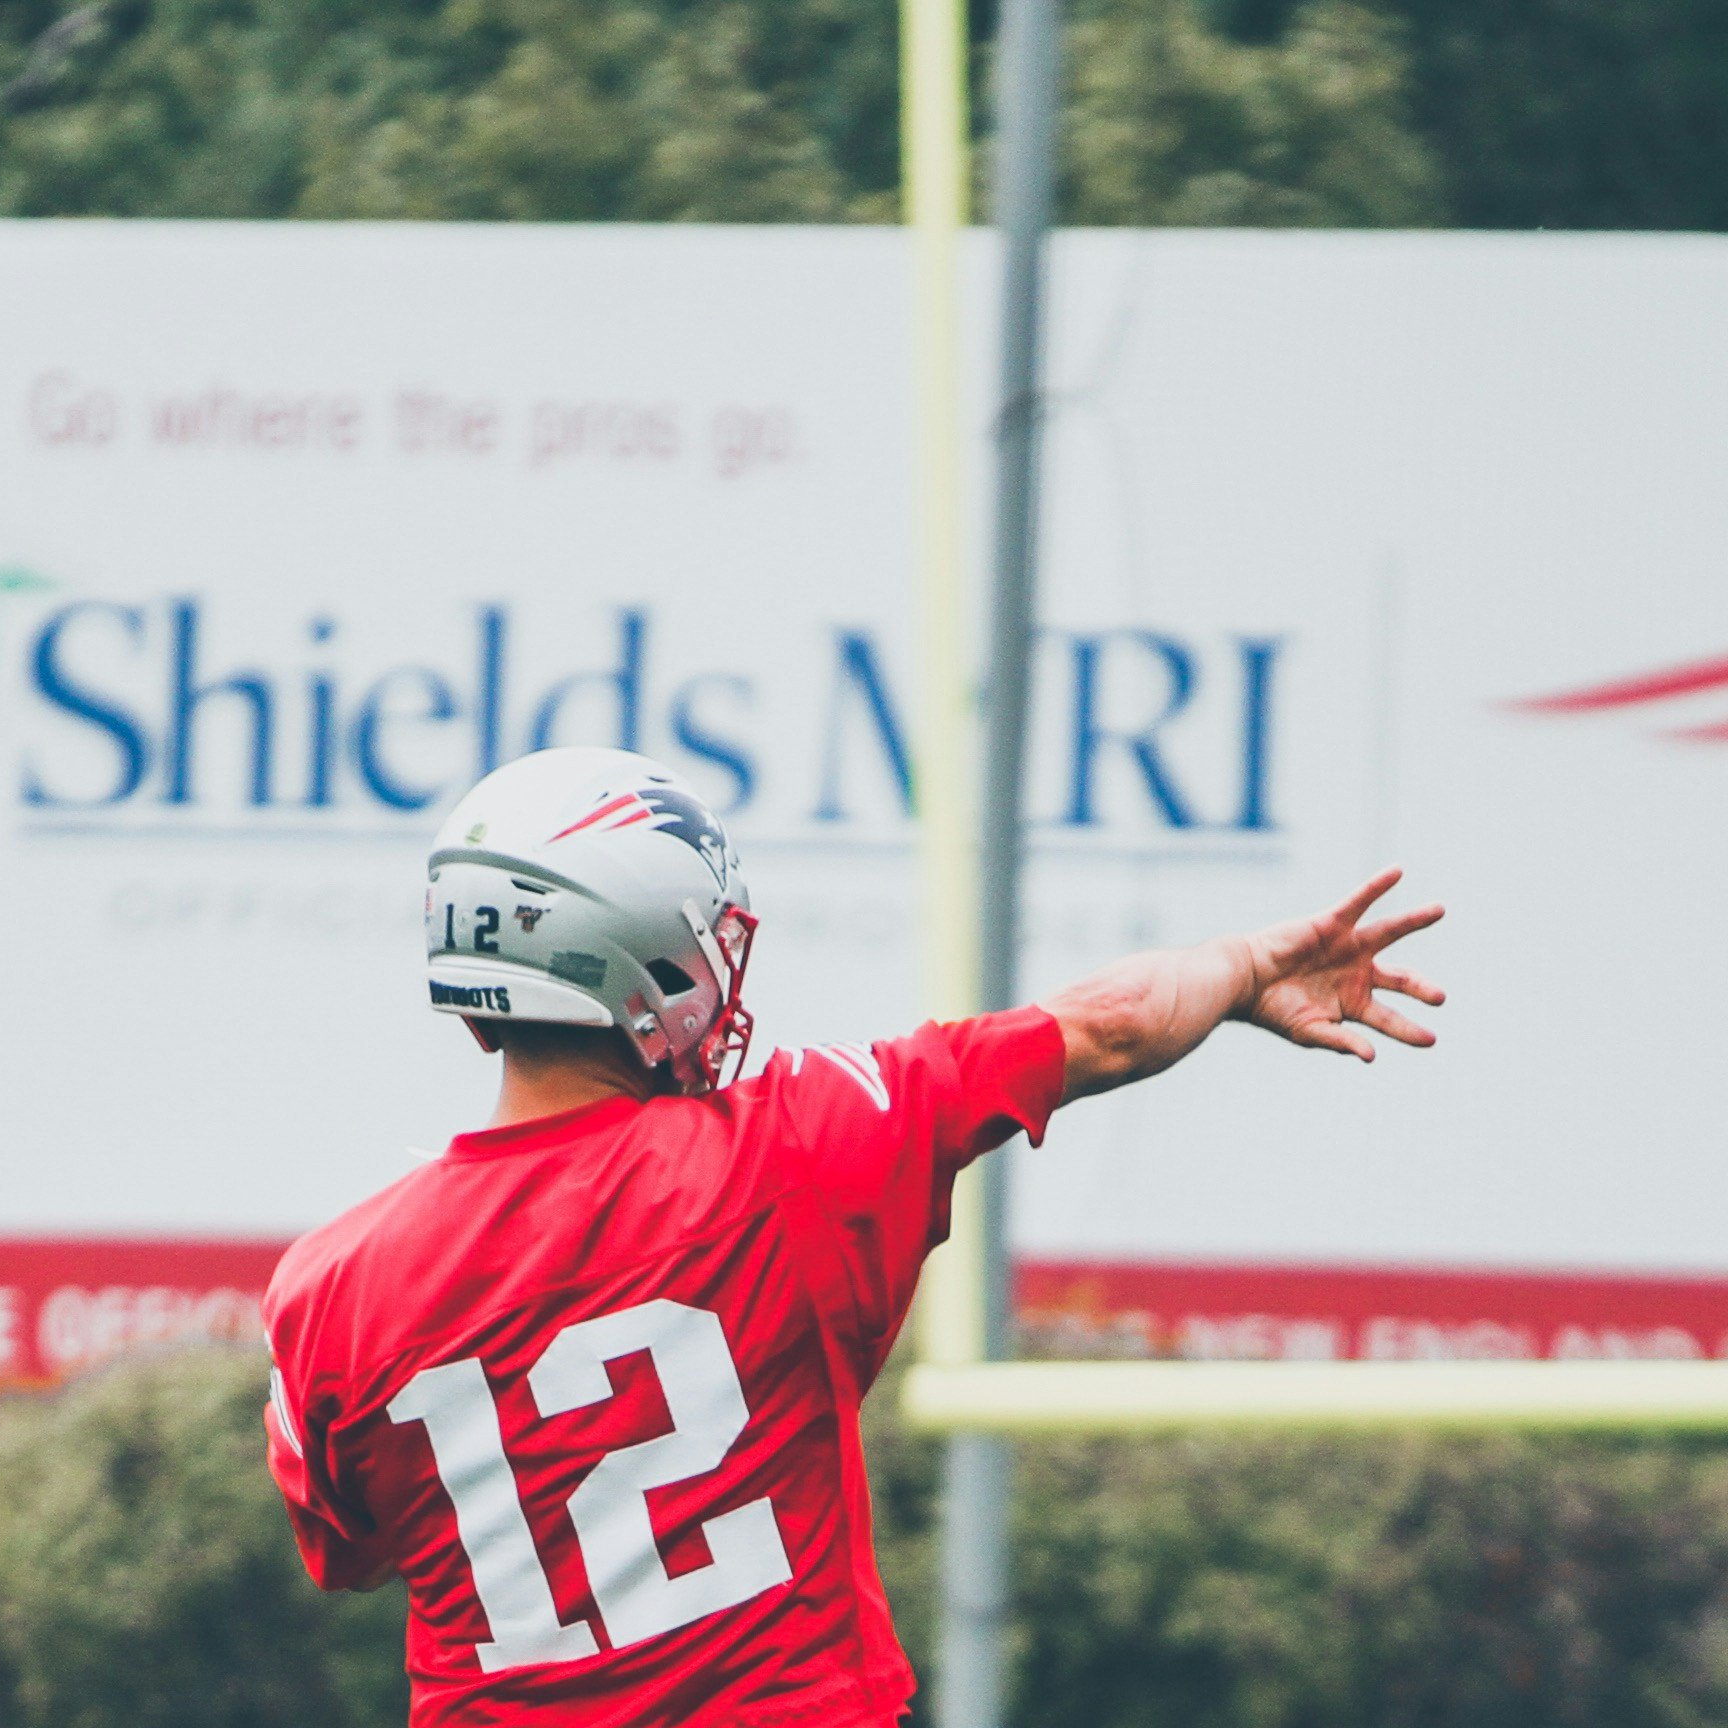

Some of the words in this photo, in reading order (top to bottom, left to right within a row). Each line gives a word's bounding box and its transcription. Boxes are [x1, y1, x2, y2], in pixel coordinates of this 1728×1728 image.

[392, 380, 502, 454] the
[524, 394, 684, 474] pros
[20, 592, 762, 816] Shields
[36, 1286, 269, 1364] OFFIC
[385, 1297, 794, 1674] 12
